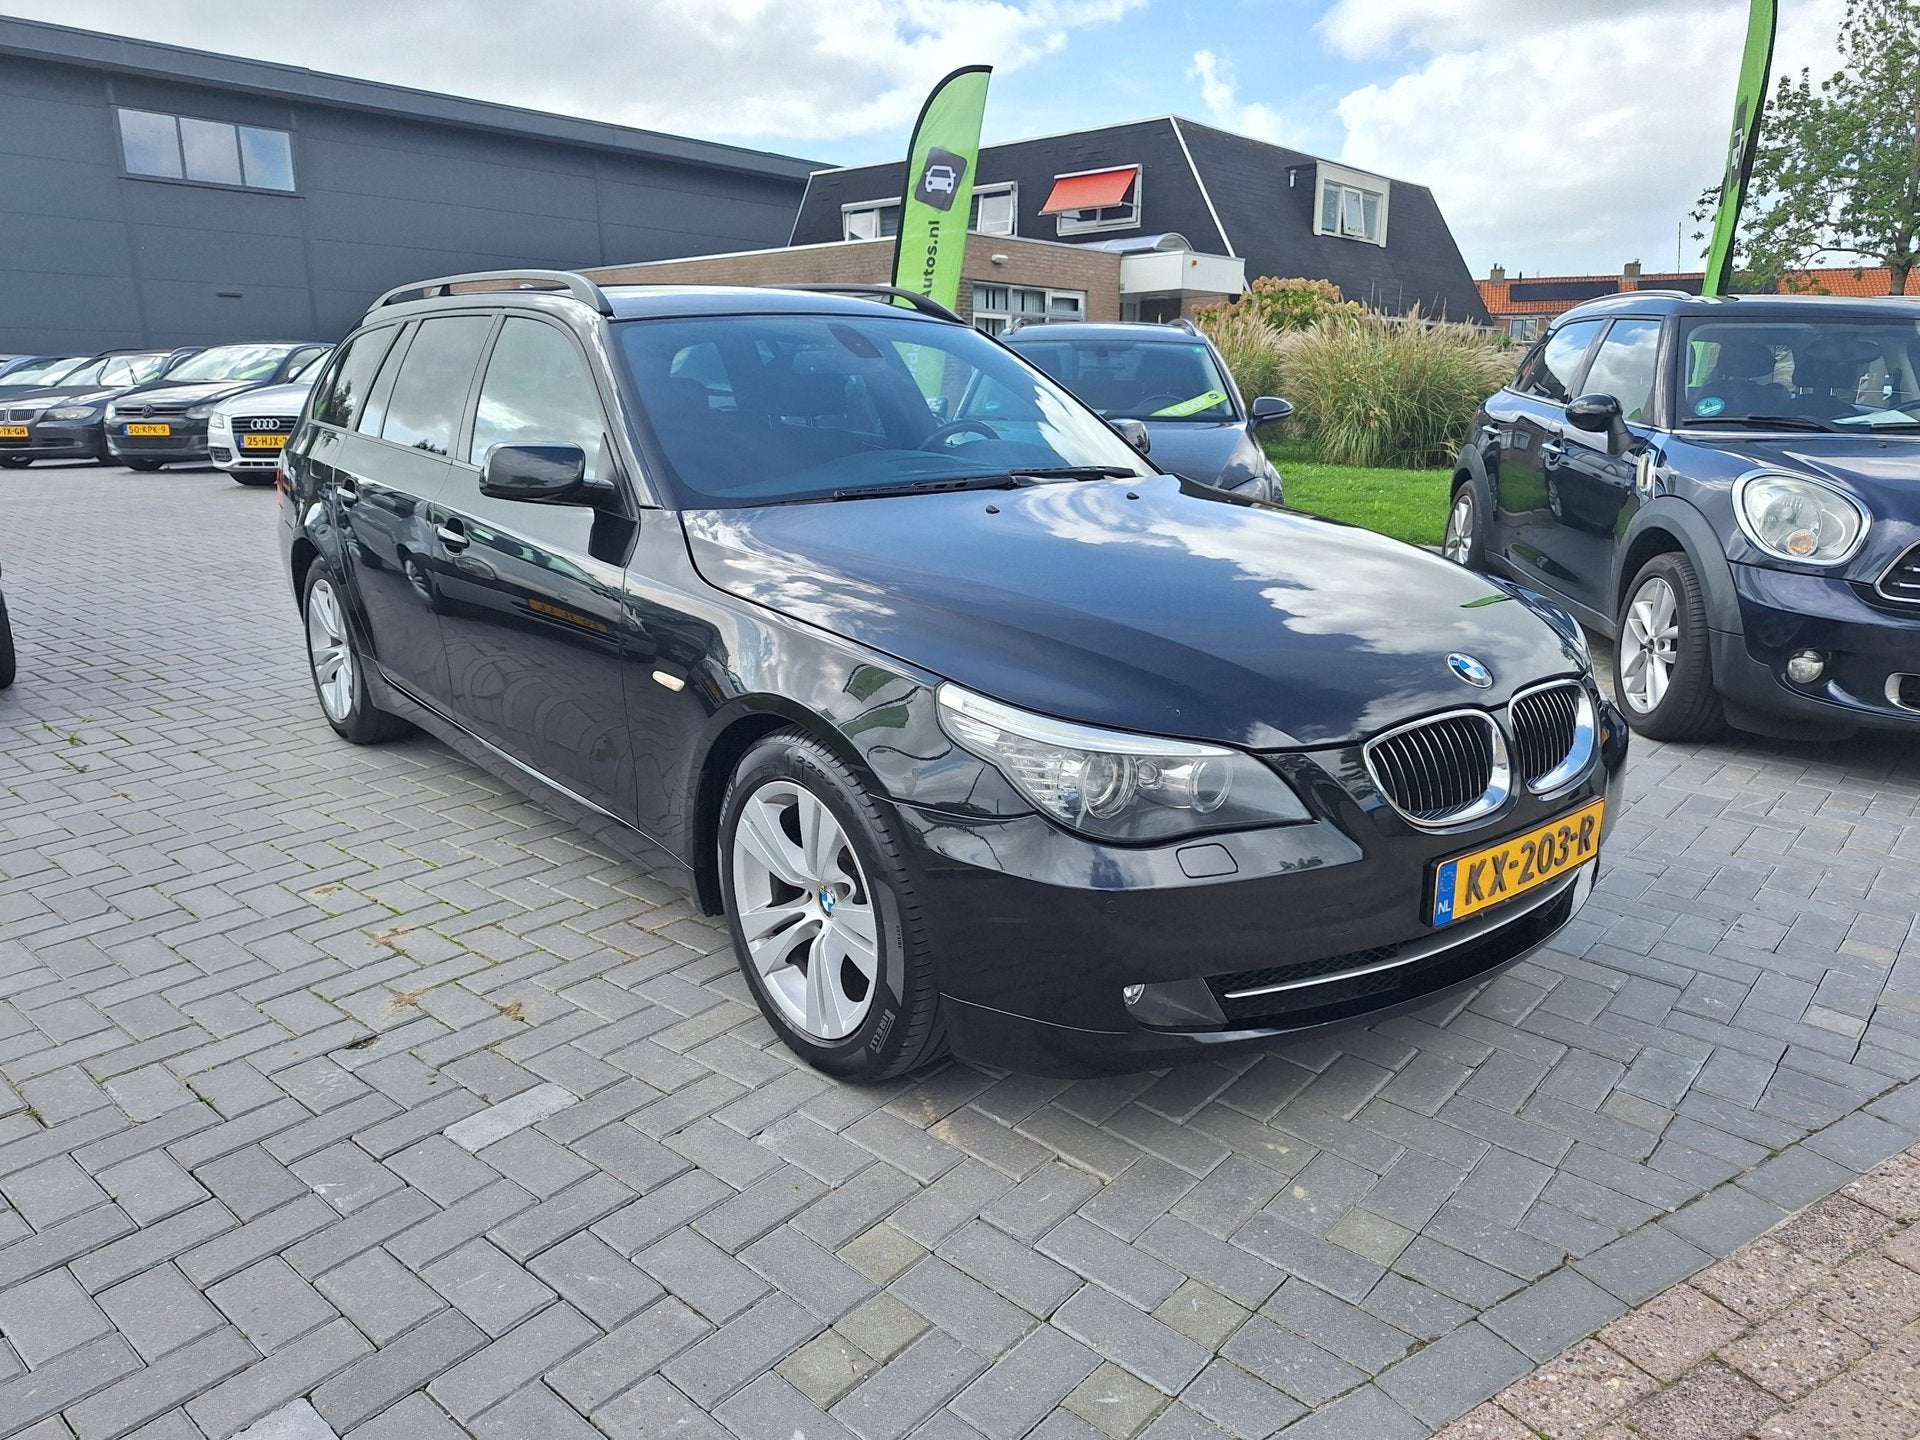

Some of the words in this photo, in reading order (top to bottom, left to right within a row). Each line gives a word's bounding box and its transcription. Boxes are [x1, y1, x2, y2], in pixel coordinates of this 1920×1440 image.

[128, 426, 166, 434] 50-KPK-9
[1464, 813, 1595, 906] KX-203-R
[1437, 899, 1452, 915] NL
[869, 1008, 896, 1054] PIRELLI
